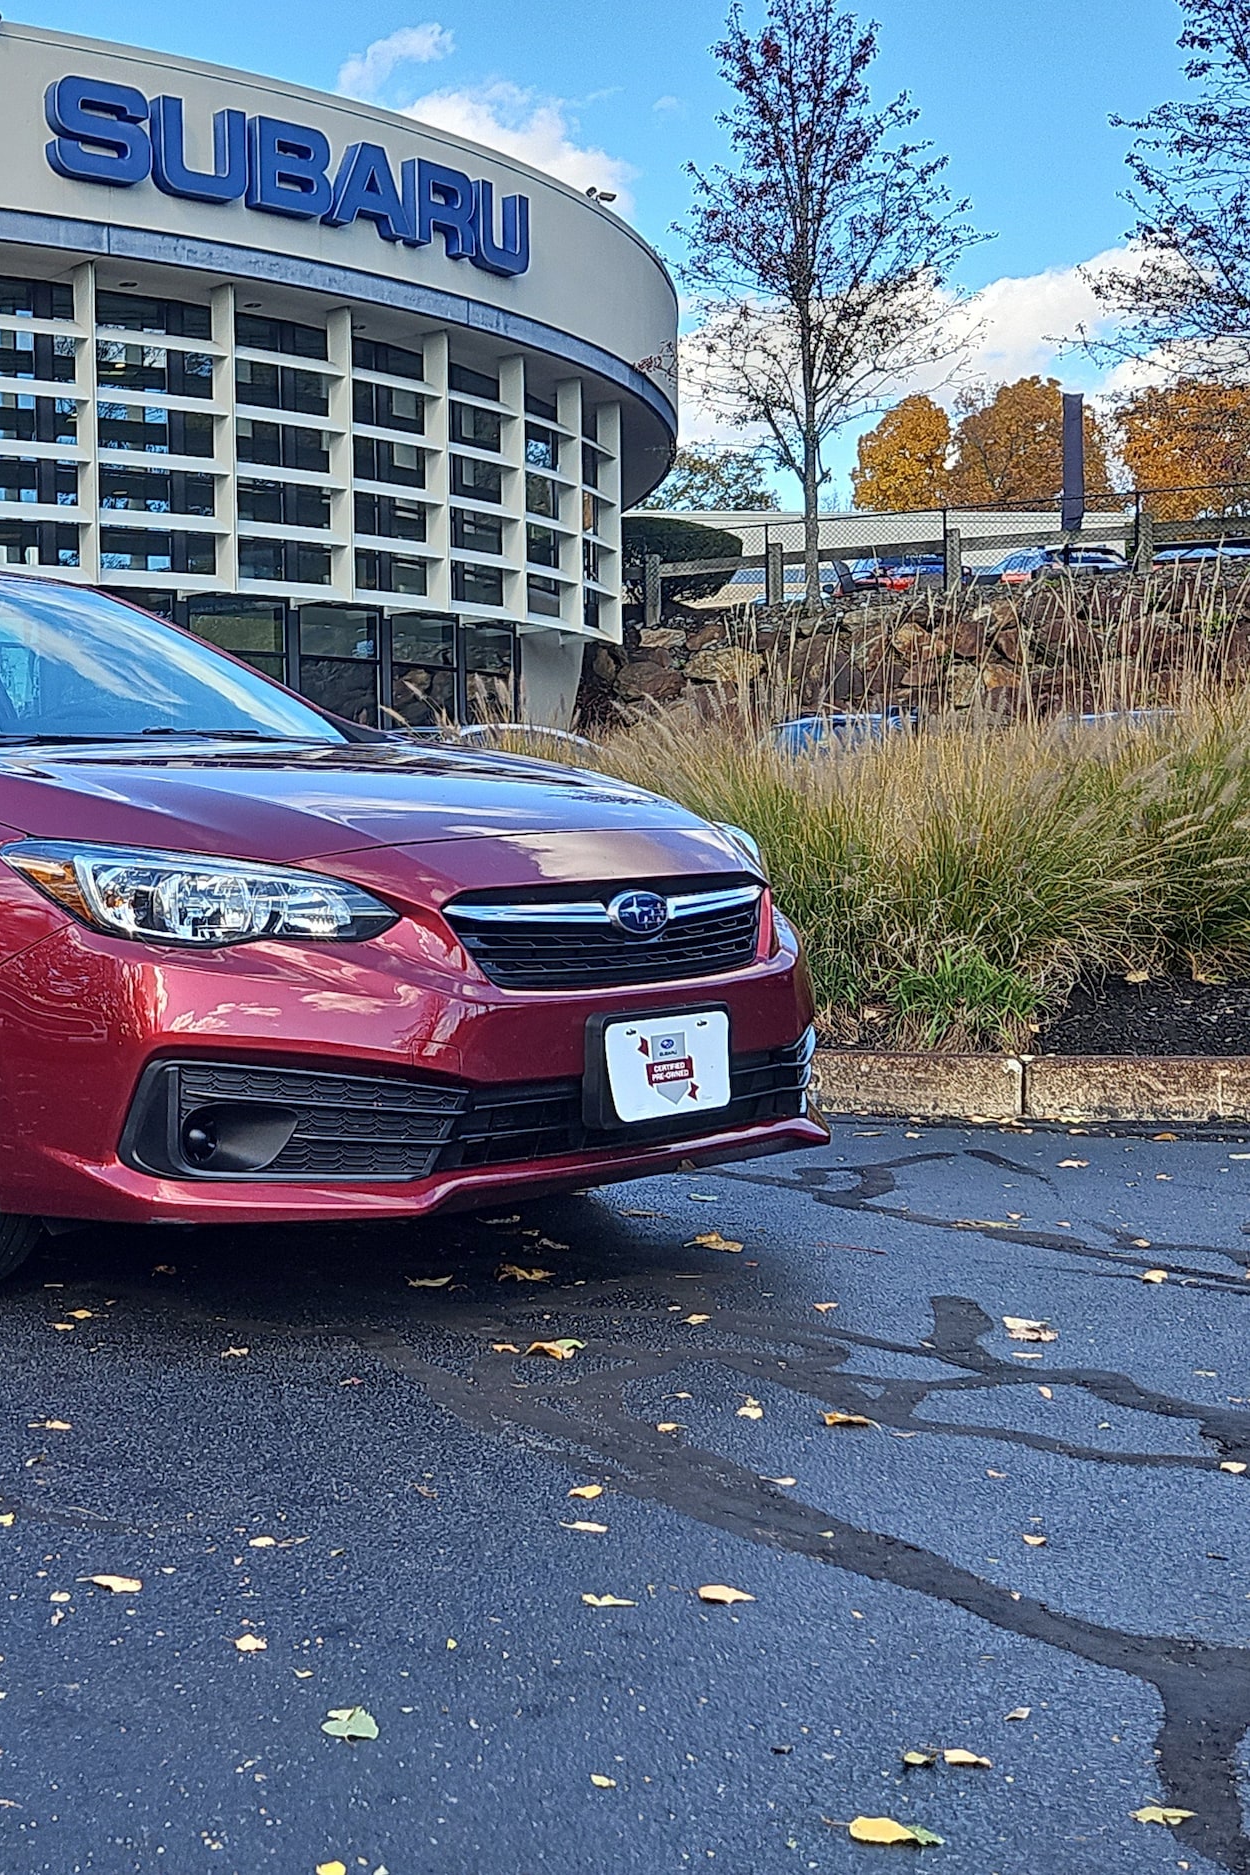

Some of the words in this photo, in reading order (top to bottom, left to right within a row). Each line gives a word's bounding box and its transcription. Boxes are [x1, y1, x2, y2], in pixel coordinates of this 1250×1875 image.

[44, 74, 530, 278] SUBARU
[654, 1062, 685, 1072] CERTIFIED
[652, 1070, 689, 1081] PRE-OWNED
